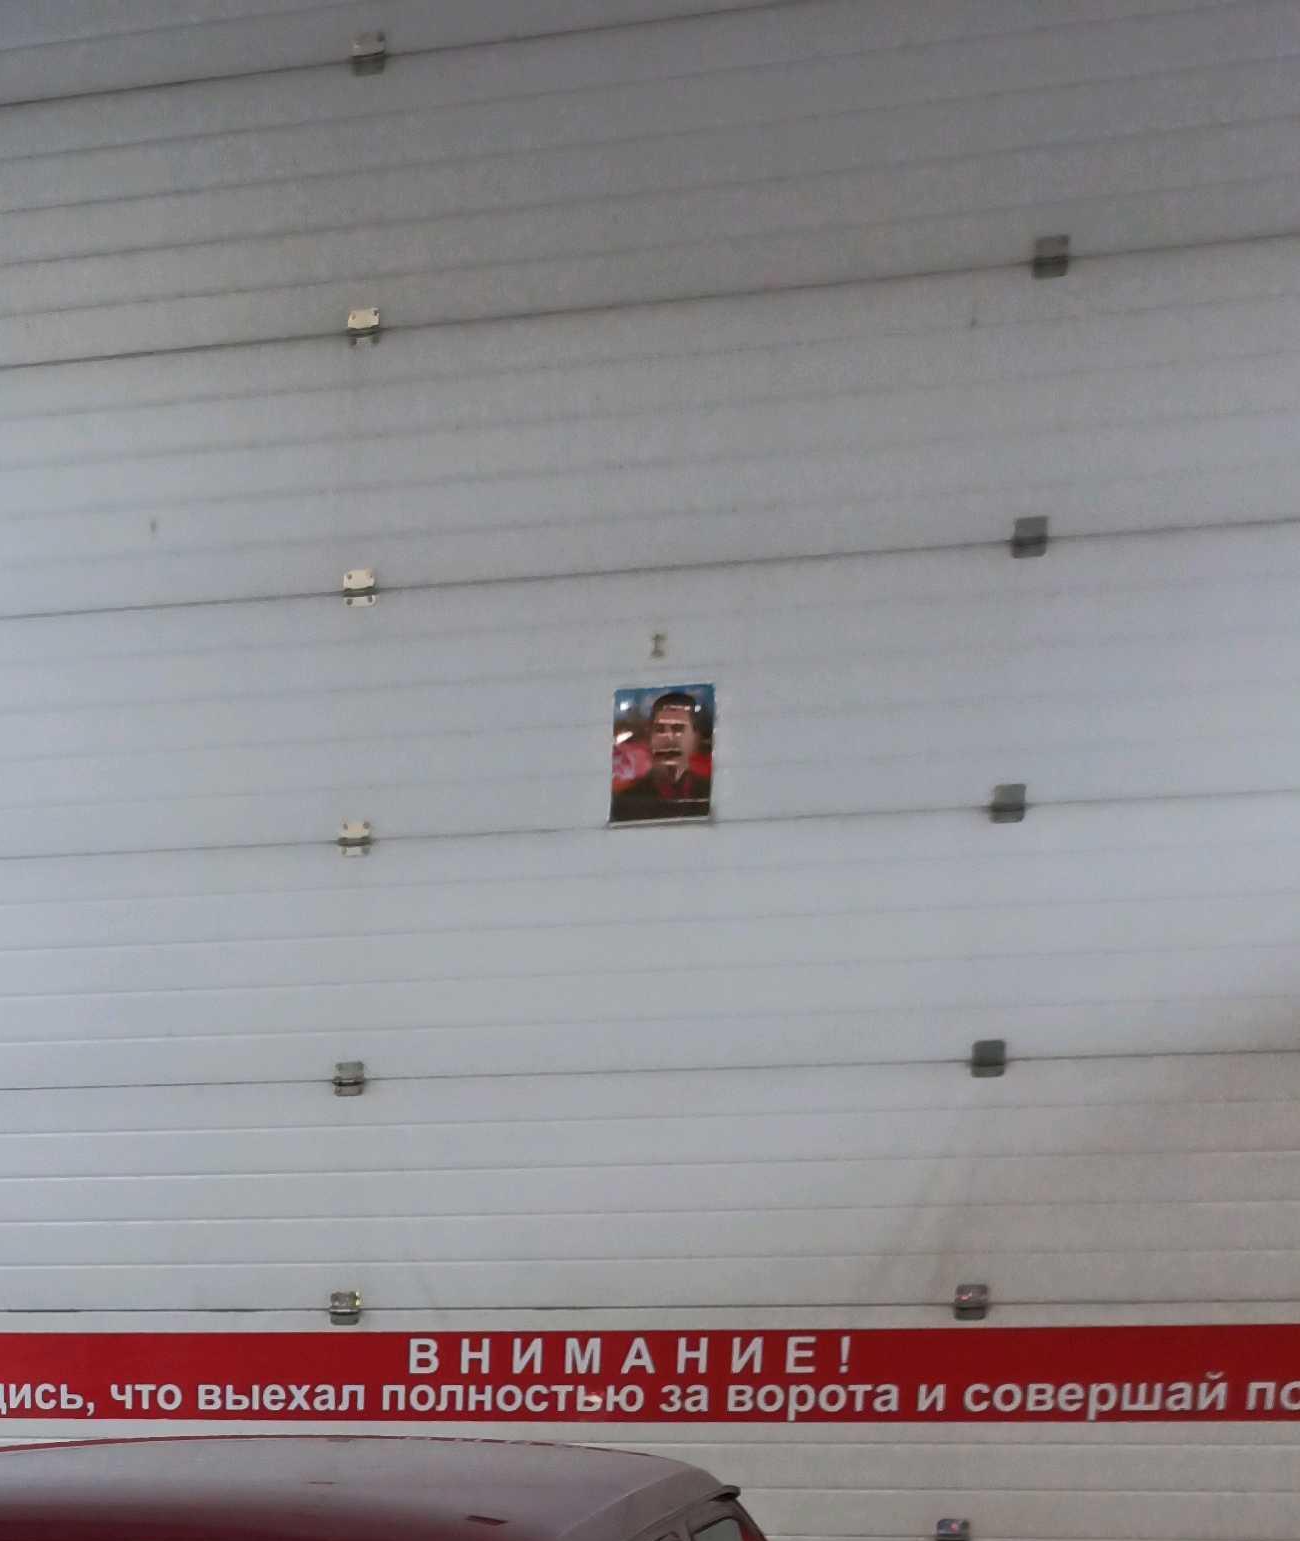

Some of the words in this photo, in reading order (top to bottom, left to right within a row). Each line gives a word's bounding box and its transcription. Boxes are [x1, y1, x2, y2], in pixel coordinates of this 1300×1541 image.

[409, 1336, 851, 1374] ВНИМАНИЕ!
[110, 1383, 183, 1411] что
[197, 1383, 365, 1411] выехал
[382, 1384, 645, 1413] полностью
[659, 1384, 709, 1413] за
[727, 1383, 899, 1420] ворота
[917, 1383, 946, 1412] и
[964, 1371, 1228, 1420] совершай
